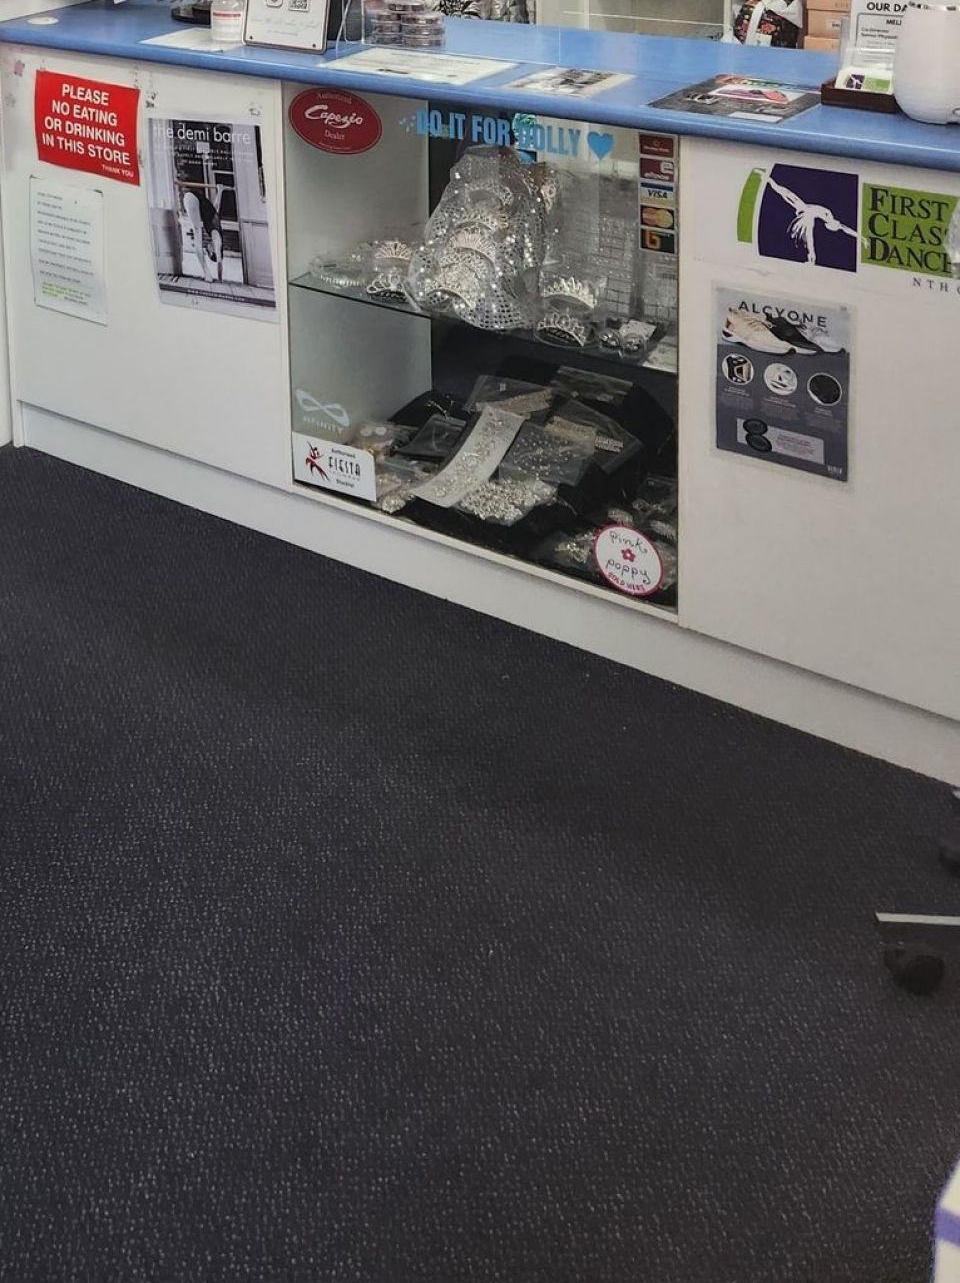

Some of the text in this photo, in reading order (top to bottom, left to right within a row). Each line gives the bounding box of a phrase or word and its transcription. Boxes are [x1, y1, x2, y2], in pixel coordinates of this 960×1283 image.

[866, 1, 890, 12] OUR
[62, 83, 109, 106] PLEASE
[52, 100, 118, 127] NO EATING
[304, 104, 364, 129] Capezio
[44, 116, 125, 147] OR DRINKING
[177, 123, 210, 141] demi
[213, 126, 252, 145] barre
[416, 108, 582, 158] DO IT FOR DOLLY
[42, 133, 131, 165] IN THIS STORE
[102, 164, 135, 178] THANK YOU
[648, 189, 668, 199] VISA
[869, 187, 949, 222] FIRST
[868, 213, 948, 246] CLAS
[912, 277, 948, 293] NTH
[738, 300, 828, 328] ALCYONE
[328, 456, 360, 477] FIESTA
[609, 530, 648, 554] pink
[605, 558, 652, 586] poppy
